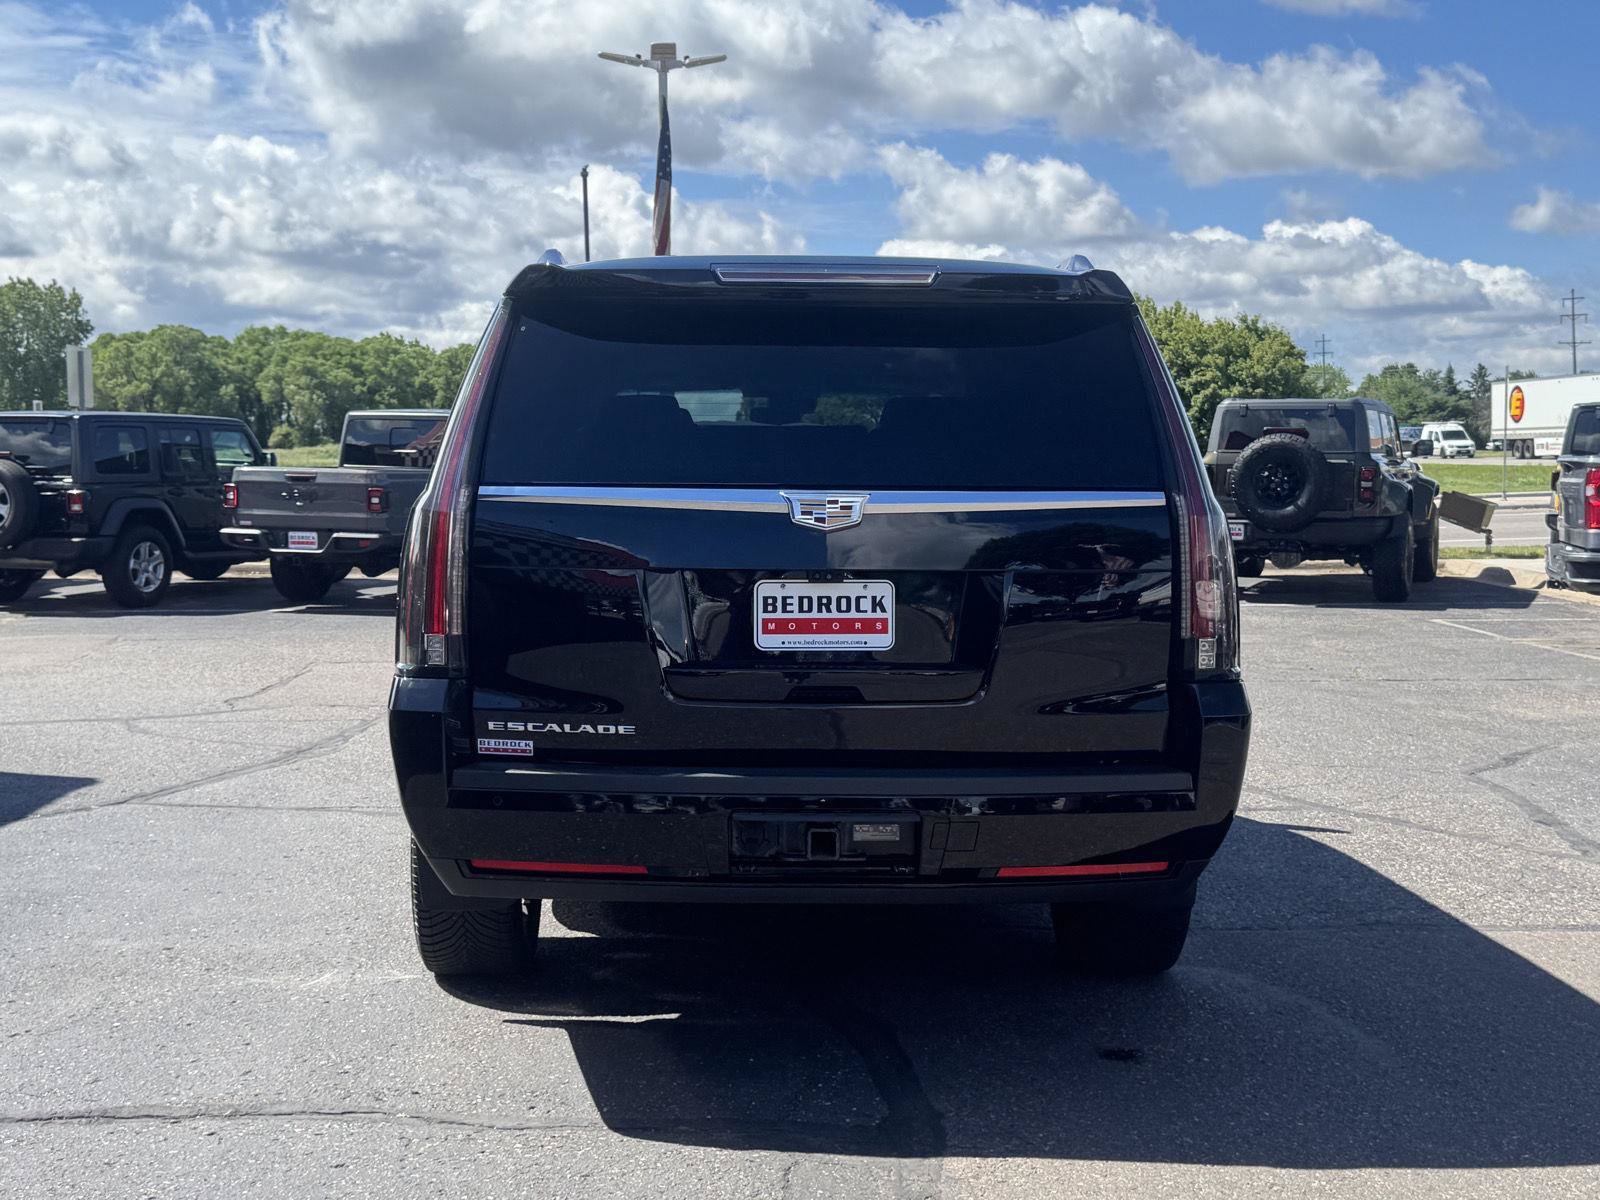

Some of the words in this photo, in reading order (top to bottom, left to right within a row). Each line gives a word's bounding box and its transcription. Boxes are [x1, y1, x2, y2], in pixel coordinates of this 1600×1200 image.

[762, 595, 888, 614] BEDROCK
[767, 622, 883, 630] MOTORS
[487, 721, 636, 735] ESCALADE
[479, 739, 532, 748] BEDROCK
